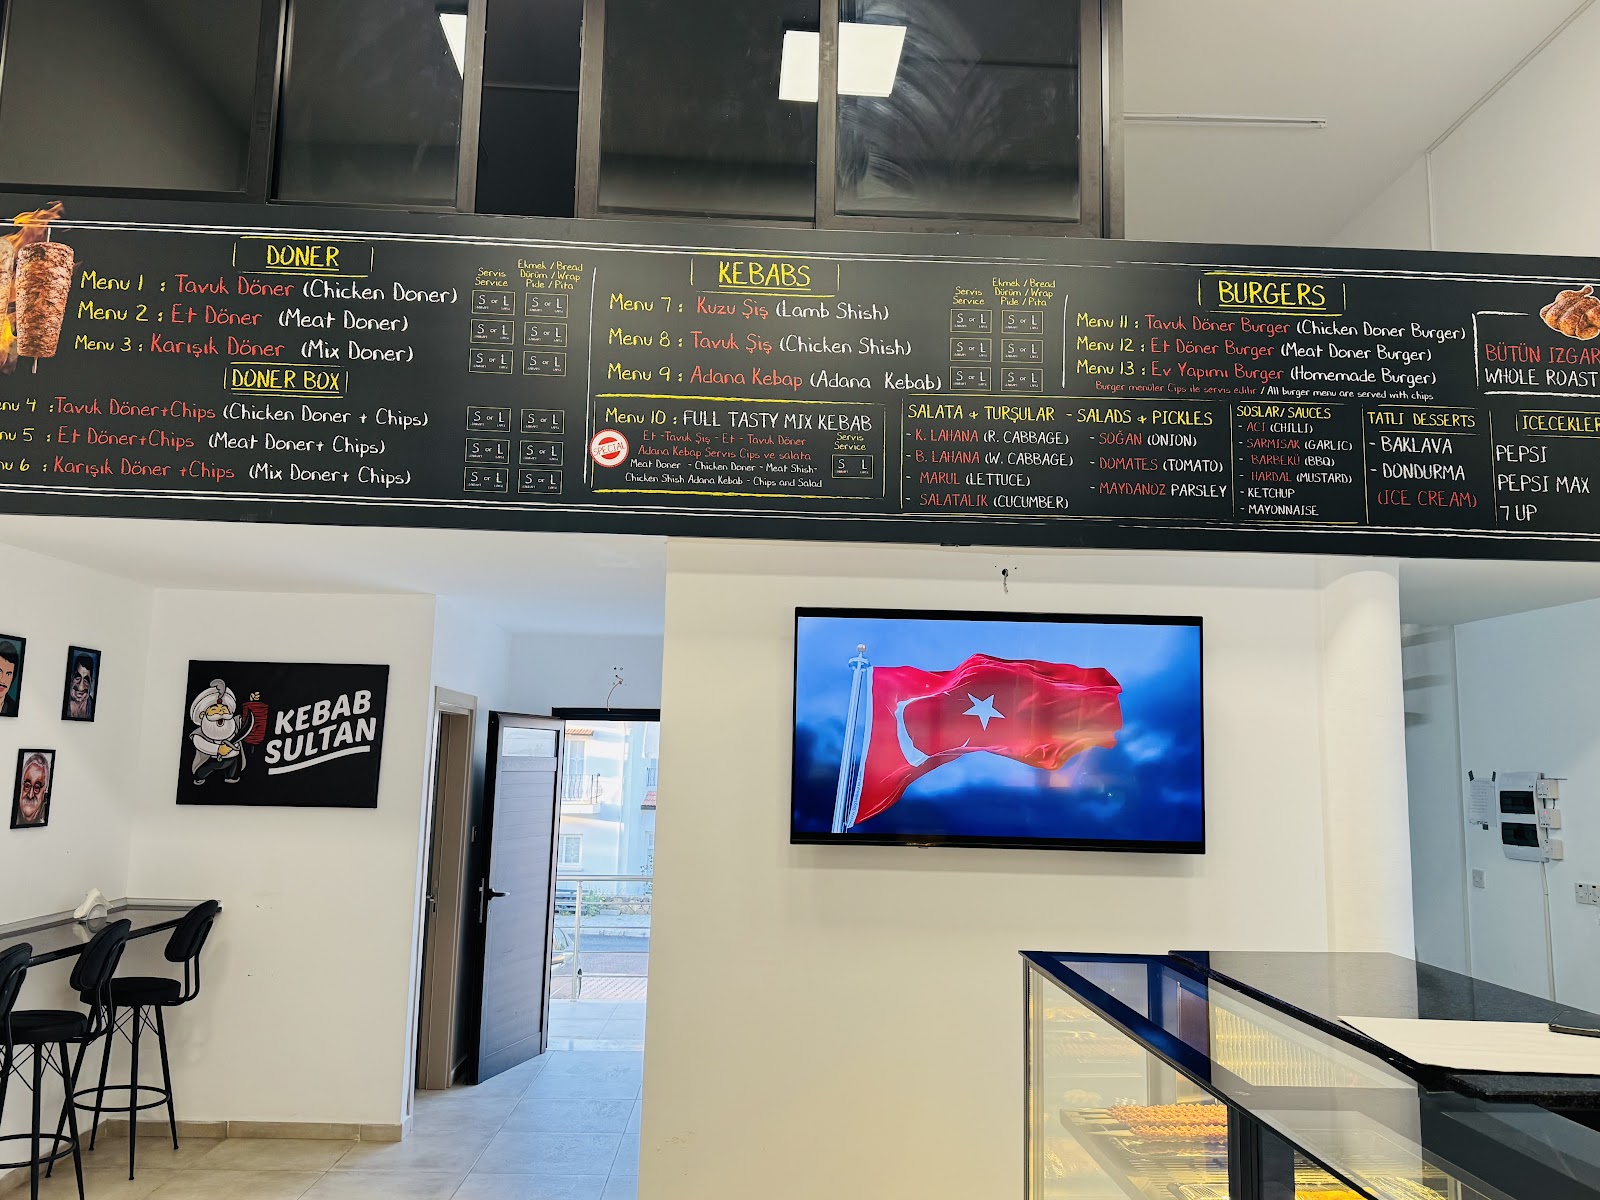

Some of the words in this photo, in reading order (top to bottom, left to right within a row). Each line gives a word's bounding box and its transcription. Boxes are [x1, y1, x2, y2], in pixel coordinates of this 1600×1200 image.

[266, 245, 340, 266] DONER
[478, 267, 507, 278] Servis
[517, 259, 546, 270] Ekmek
[556, 261, 583, 271] Bread
[718, 260, 811, 286] KEBABS
[475, 277, 508, 287] Service
[520, 270, 548, 279] Dürüm
[557, 271, 580, 282] Wrap
[526, 279, 545, 288] Pide
[554, 281, 574, 290] Pita
[80, 270, 129, 292] Menu
[174, 273, 230, 295] Tavuk
[238, 276, 295, 297] Döner
[302, 279, 386, 301] (Chicken
[393, 282, 459, 305] Doner)
[1219, 280, 1326, 305] BURGERS
[479, 294, 486, 305] S
[503, 295, 509, 306] L
[609, 292, 654, 313] Menu
[660, 296, 672, 311] 7
[696, 296, 736, 315] Kuzu
[776, 300, 830, 319] (Lamb
[836, 300, 889, 321] Shish)
[77, 301, 130, 321] Menu
[135, 305, 150, 322] 2
[171, 304, 195, 325] Et
[204, 306, 263, 326] Döner
[278, 308, 336, 329] (Meat
[343, 311, 409, 332] Doner)
[1076, 312, 1114, 329] Menu
[1145, 314, 1187, 330] Tavuk
[1192, 316, 1235, 332] Döner
[1240, 316, 1290, 339] Burger
[1296, 319, 1358, 336] (Chicken
[1363, 321, 1405, 337] Doner
[1411, 322, 1466, 344] Burger)
[74, 334, 116, 352] Menu
[121, 336, 133, 352] 3
[150, 332, 219, 358] Karışık
[227, 336, 286, 357] Döner
[301, 338, 340, 360] (Mix
[348, 341, 414, 363] Doner)
[608, 327, 654, 347] Menu
[659, 331, 672, 347] 8
[690, 330, 739, 350] Tavuk
[780, 333, 853, 354] (Chicken
[858, 336, 912, 356] Shish)
[1485, 341, 1540, 363] BÜTÜN
[230, 368, 297, 389] DONER
[302, 370, 340, 390] BOX
[1076, 359, 1114, 375] Menu
[1120, 361, 1135, 376] 13
[1152, 361, 1172, 377] Ev
[1234, 364, 1284, 385] Burger
[1290, 364, 1376, 382] (Homemade
[1381, 367, 1436, 388] Burger)
[1484, 368, 1540, 385] WHOLE
[1546, 369, 1598, 388] ROAST
[1267, 386, 1279, 395] All
[1282, 387, 1310, 398] burger
[1358, 390, 1386, 399] served
[1390, 391, 1408, 400] with
[1411, 392, 1434, 402] chips
[26, 398, 36, 412] 4
[222, 402, 294, 421] (Chicken
[301, 404, 351, 423] Doner
[376, 407, 428, 430] Chips)
[605, 407, 644, 424] Menu
[650, 410, 666, 424] 10
[683, 410, 720, 427] FULL
[727, 411, 778, 428] TASTY
[784, 413, 812, 430] MIX
[818, 414, 872, 432] KEBAB
[908, 404, 964, 419] SALATA
[984, 405, 1055, 424] TURŞULAR
[1077, 408, 1132, 424] SALADS
[1152, 410, 1213, 426] PICKLES
[1367, 410, 1405, 426] TATLI
[1413, 413, 1476, 429] DESSERTS
[836, 432, 864, 441] Servis
[915, 428, 926, 441] K.
[931, 429, 979, 442] LAHANA
[984, 430, 999, 443] (R.
[1003, 430, 1069, 445] CABBAGE)
[1246, 422, 1265, 432] ACI
[1270, 422, 1313, 434] (CHILLI)
[644, 430, 656, 441] Et
[747, 434, 774, 444] Tavuk
[778, 435, 806, 446] Döner
[834, 442, 866, 451] Service
[1098, 430, 1142, 445] SOĞAN
[1147, 433, 1197, 447] (ONION)
[1246, 438, 1300, 450] SARMISAK
[1304, 439, 1353, 451] (GARLIC)
[1380, 435, 1453, 454] BAKLAVA
[593, 442, 626, 457] SPECIAL
[638, 444, 670, 456] Adana
[673, 445, 702, 459] Kebap
[780, 450, 812, 460] salata
[915, 450, 928, 462] B.
[932, 450, 980, 464] LAHANA
[985, 452, 1004, 465] (W.
[1008, 452, 1074, 466] CABBAGE)
[1496, 444, 1547, 463] PEPSI
[630, 459, 653, 468] Meat
[656, 460, 681, 469] Doner
[695, 461, 728, 470] Chicken
[731, 462, 756, 471] Doner
[766, 463, 788, 472] Meat
[838, 459, 845, 469] S
[862, 459, 867, 470] L
[1099, 457, 1158, 471] DOMATES
[1163, 458, 1224, 473] (TOMATO)
[1304, 455, 1335, 466] (BBQ)
[625, 472, 658, 482] Chicken
[661, 473, 684, 484] Shish
[688, 474, 715, 484] Adana
[718, 475, 743, 485] Kebab
[753, 476, 776, 488] Chips
[798, 478, 822, 488] Salad
[919, 471, 960, 485] MARUL
[965, 472, 1031, 487] (LETTUCE)
[1252, 471, 1292, 482] HARDAL
[1296, 472, 1352, 484] (MUSTARD)
[1382, 462, 1466, 481] DONDURMA
[1100, 482, 1166, 496] MAYDANOZ
[1171, 483, 1227, 498] PARSLEY
[1498, 474, 1550, 492] PEPSI
[1556, 476, 1590, 493] MAX
[919, 493, 988, 507] SALATALIK
[994, 494, 1069, 509] (CUCUMBER)
[1248, 487, 1295, 498] KETCHUP
[1377, 489, 1412, 506] (ICE
[1417, 490, 1477, 508] CREAM)
[1248, 504, 1319, 516] MAYONNAISE
[1500, 505, 1510, 521] 7
[1515, 504, 1537, 521] UP
[275, 690, 372, 735] KEBAB
[265, 718, 376, 764] SULTAN
